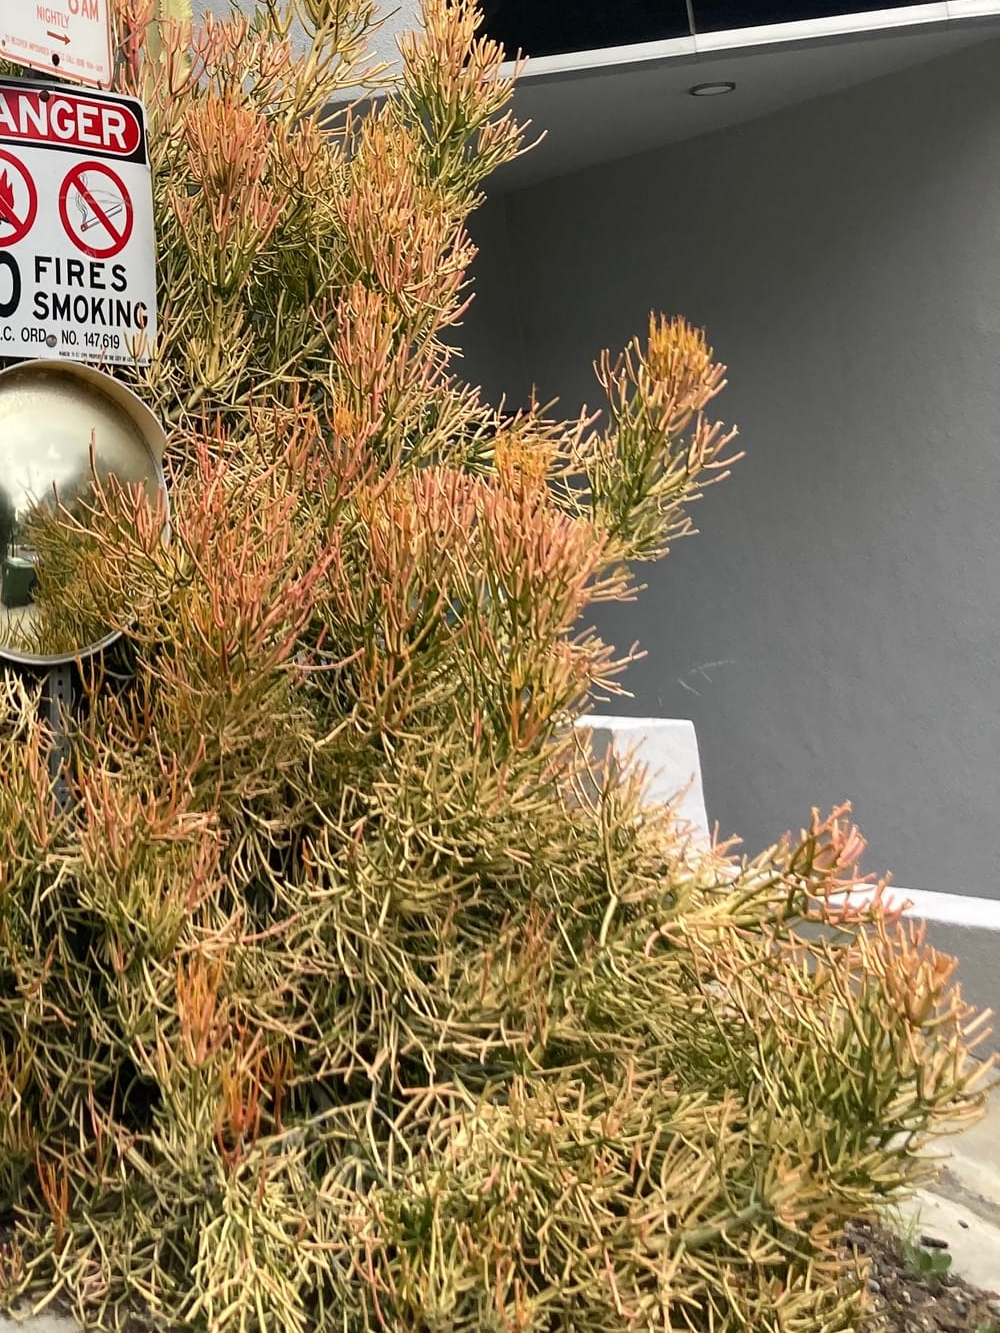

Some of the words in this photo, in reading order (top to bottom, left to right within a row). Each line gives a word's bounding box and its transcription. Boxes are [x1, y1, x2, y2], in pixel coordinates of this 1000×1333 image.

[36, 4, 70, 30] NIGHTLY
[34, 255, 128, 293] FIRES
[32, 290, 149, 330] SMOKING
[61, 329, 80, 346] NO.
[84, 331, 120, 350] 147,619
